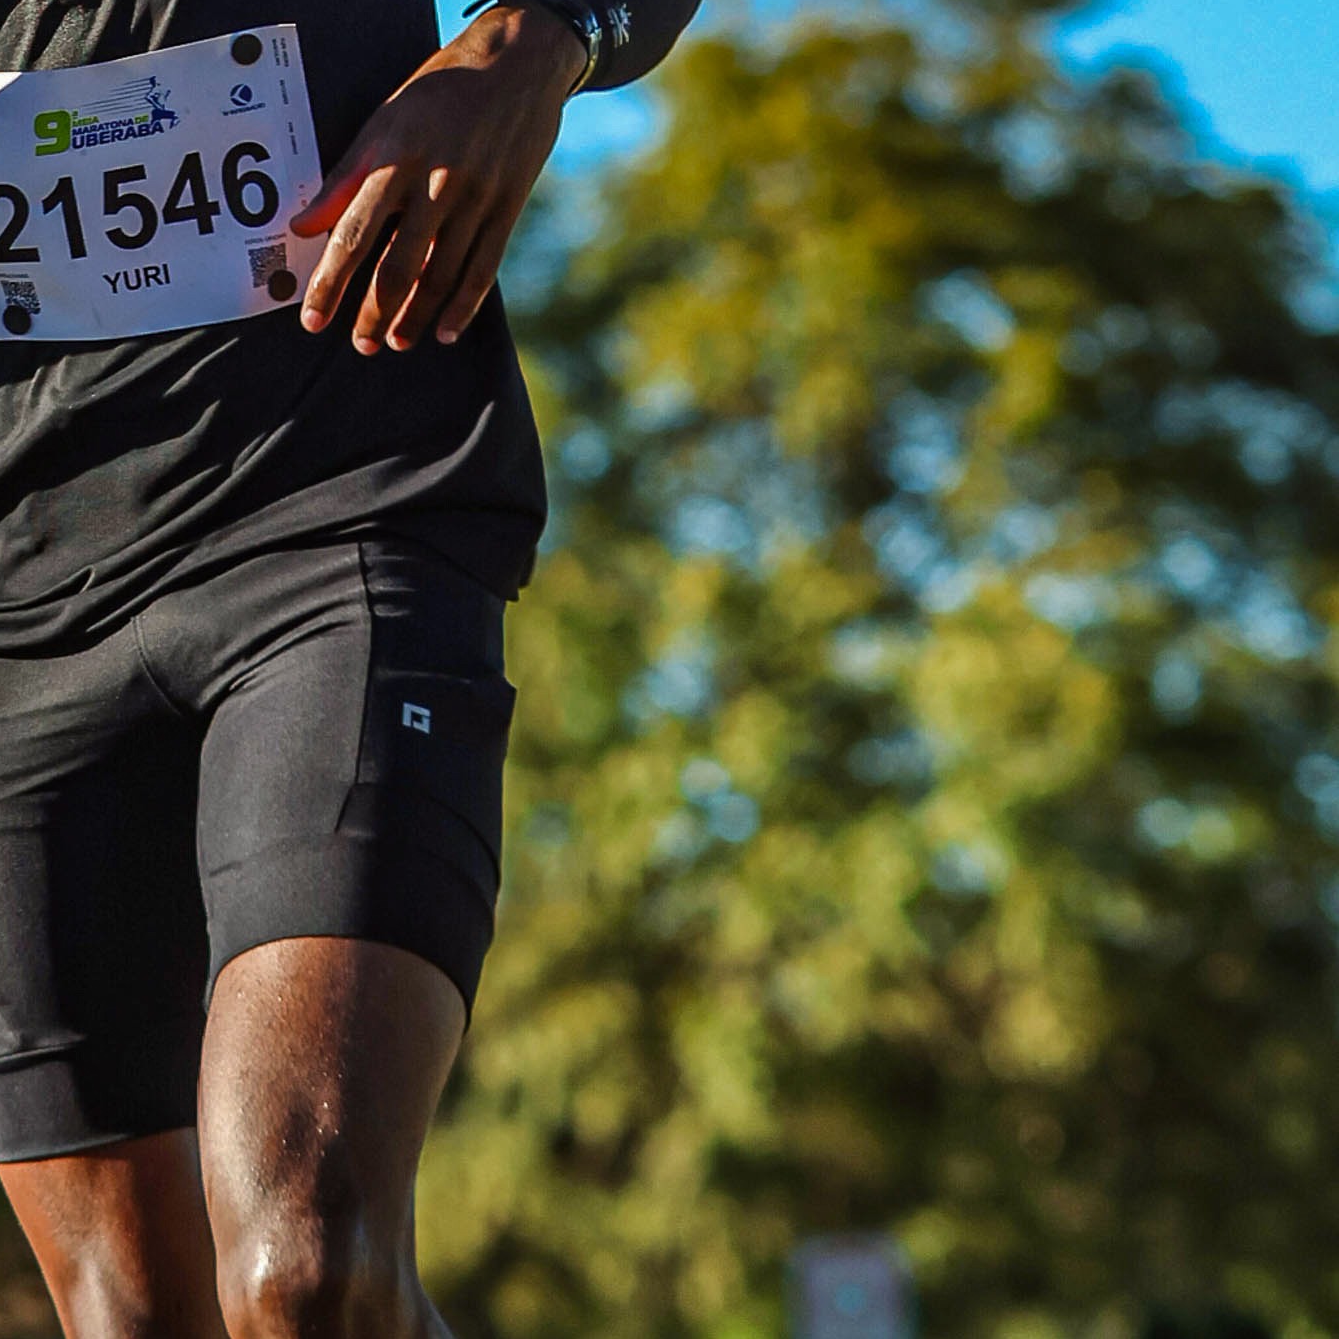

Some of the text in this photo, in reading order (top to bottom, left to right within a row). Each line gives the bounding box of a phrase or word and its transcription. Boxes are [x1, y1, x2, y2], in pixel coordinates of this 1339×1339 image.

[72, 113, 150, 136] MARATONA DE
[72, 121, 165, 149] UBERABA
[102, 263, 171, 294] YURI
